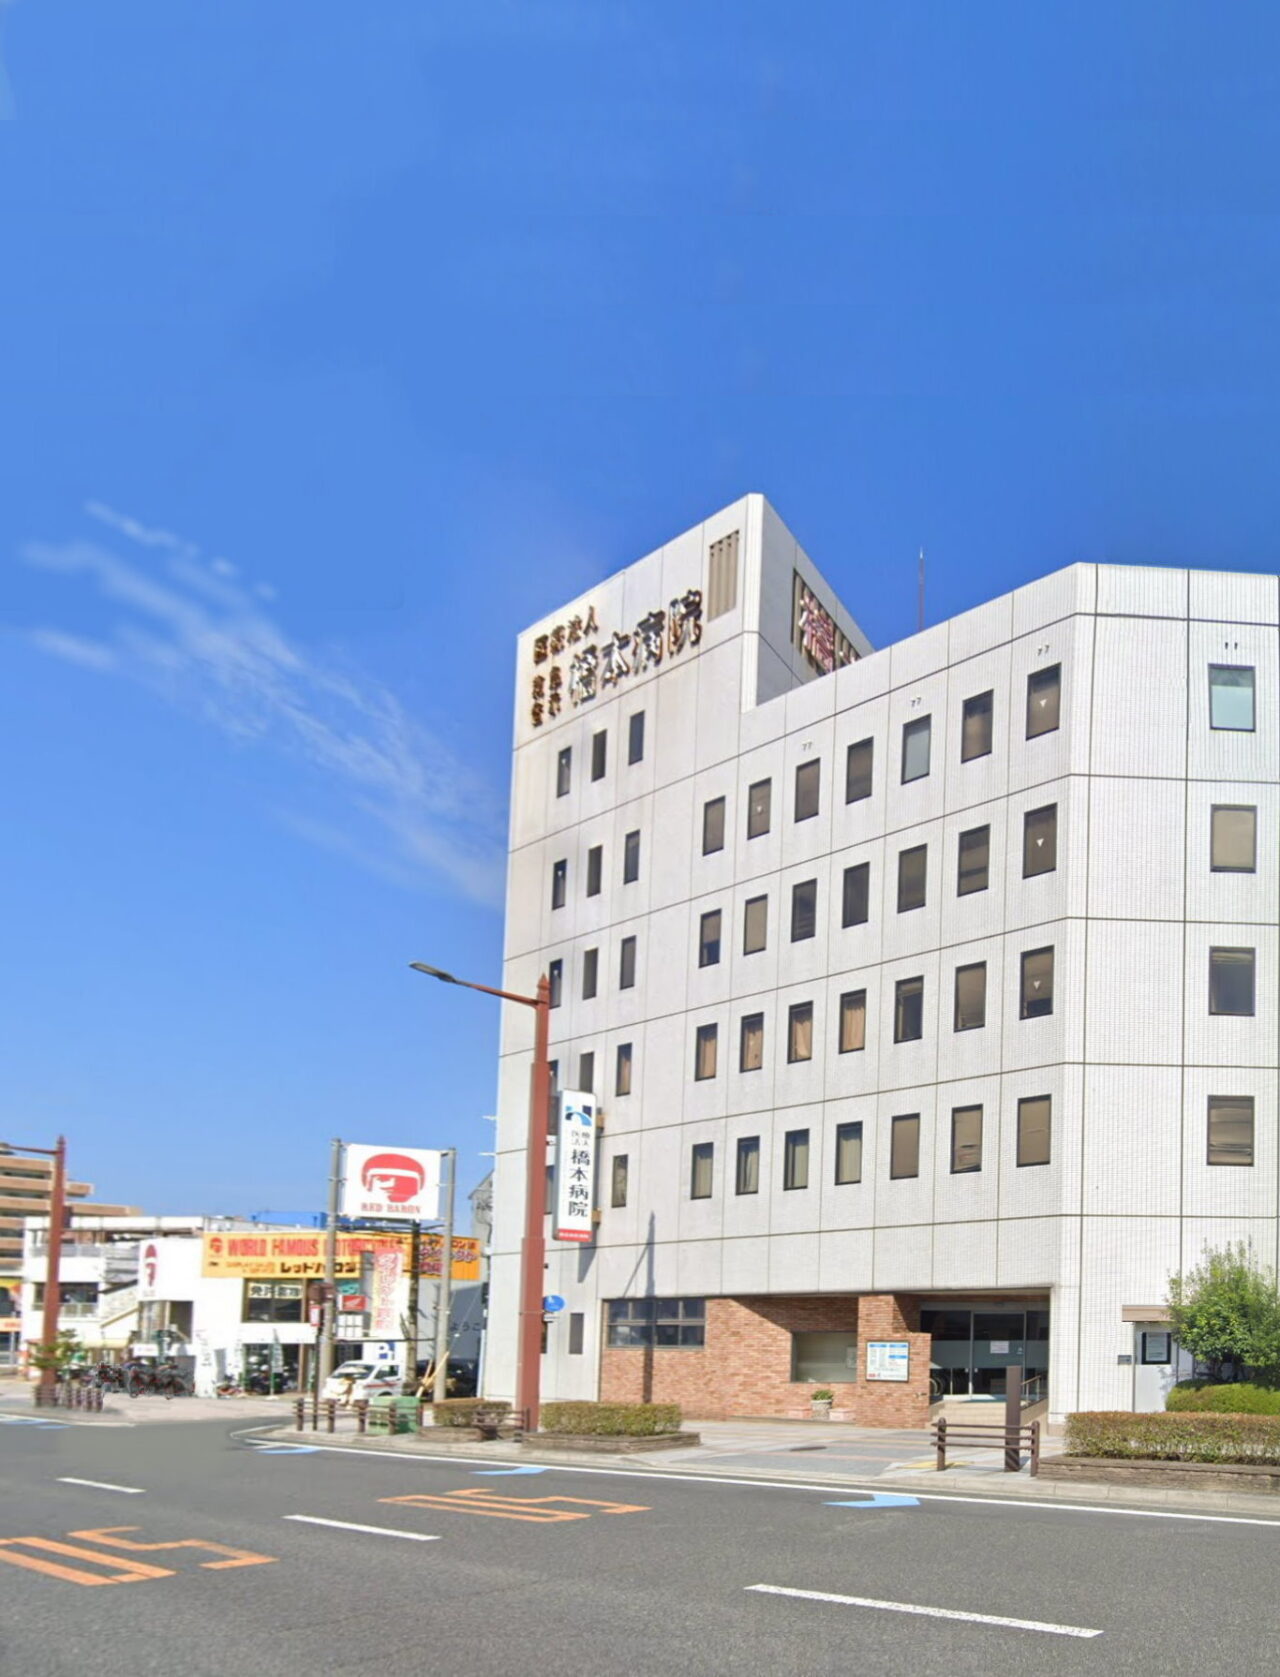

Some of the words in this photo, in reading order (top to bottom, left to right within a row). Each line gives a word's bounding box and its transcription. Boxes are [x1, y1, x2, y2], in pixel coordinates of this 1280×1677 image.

[568, 589, 703, 708] 橋本病院
[568, 1148, 590, 1217] 橋本病院
[361, 1202, 382, 1212] RED
[387, 1203, 421, 1214] BARON
[228, 1238, 267, 1257] WORLD
[272, 1238, 319, 1257] FAMOUS
